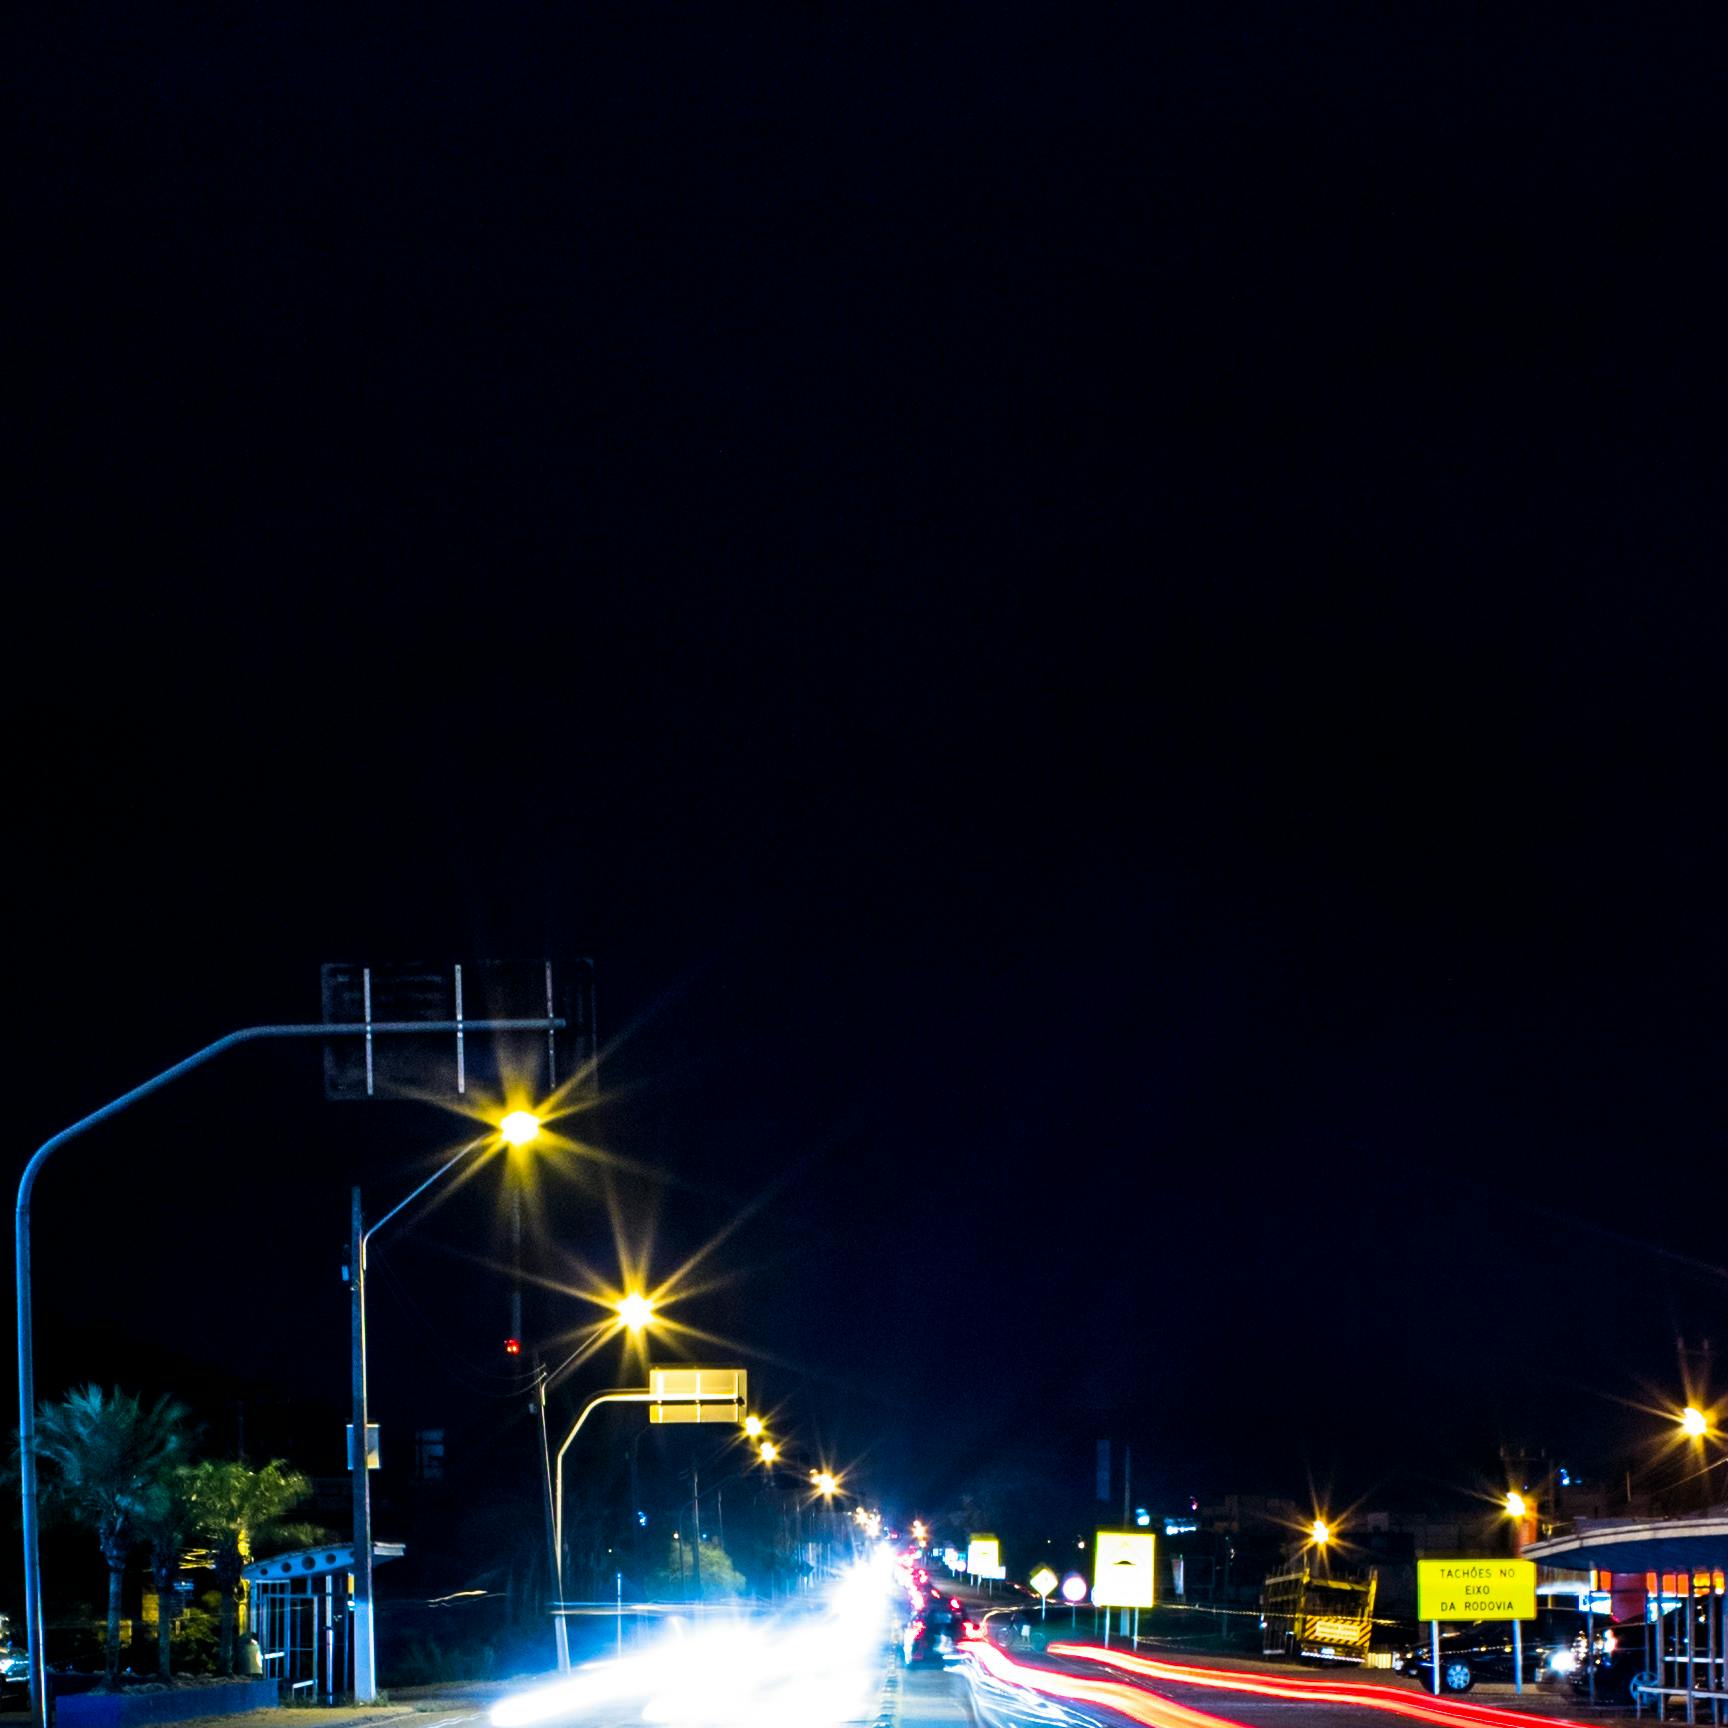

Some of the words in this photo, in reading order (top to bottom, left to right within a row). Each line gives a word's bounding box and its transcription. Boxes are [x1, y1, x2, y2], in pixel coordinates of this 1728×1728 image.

[1499, 1568, 1515, 1578] NO
[1465, 1585, 1491, 1595] EIXO
[1440, 1602, 1456, 1612] DA
[1464, 1601, 1514, 1611] RODOVIA
